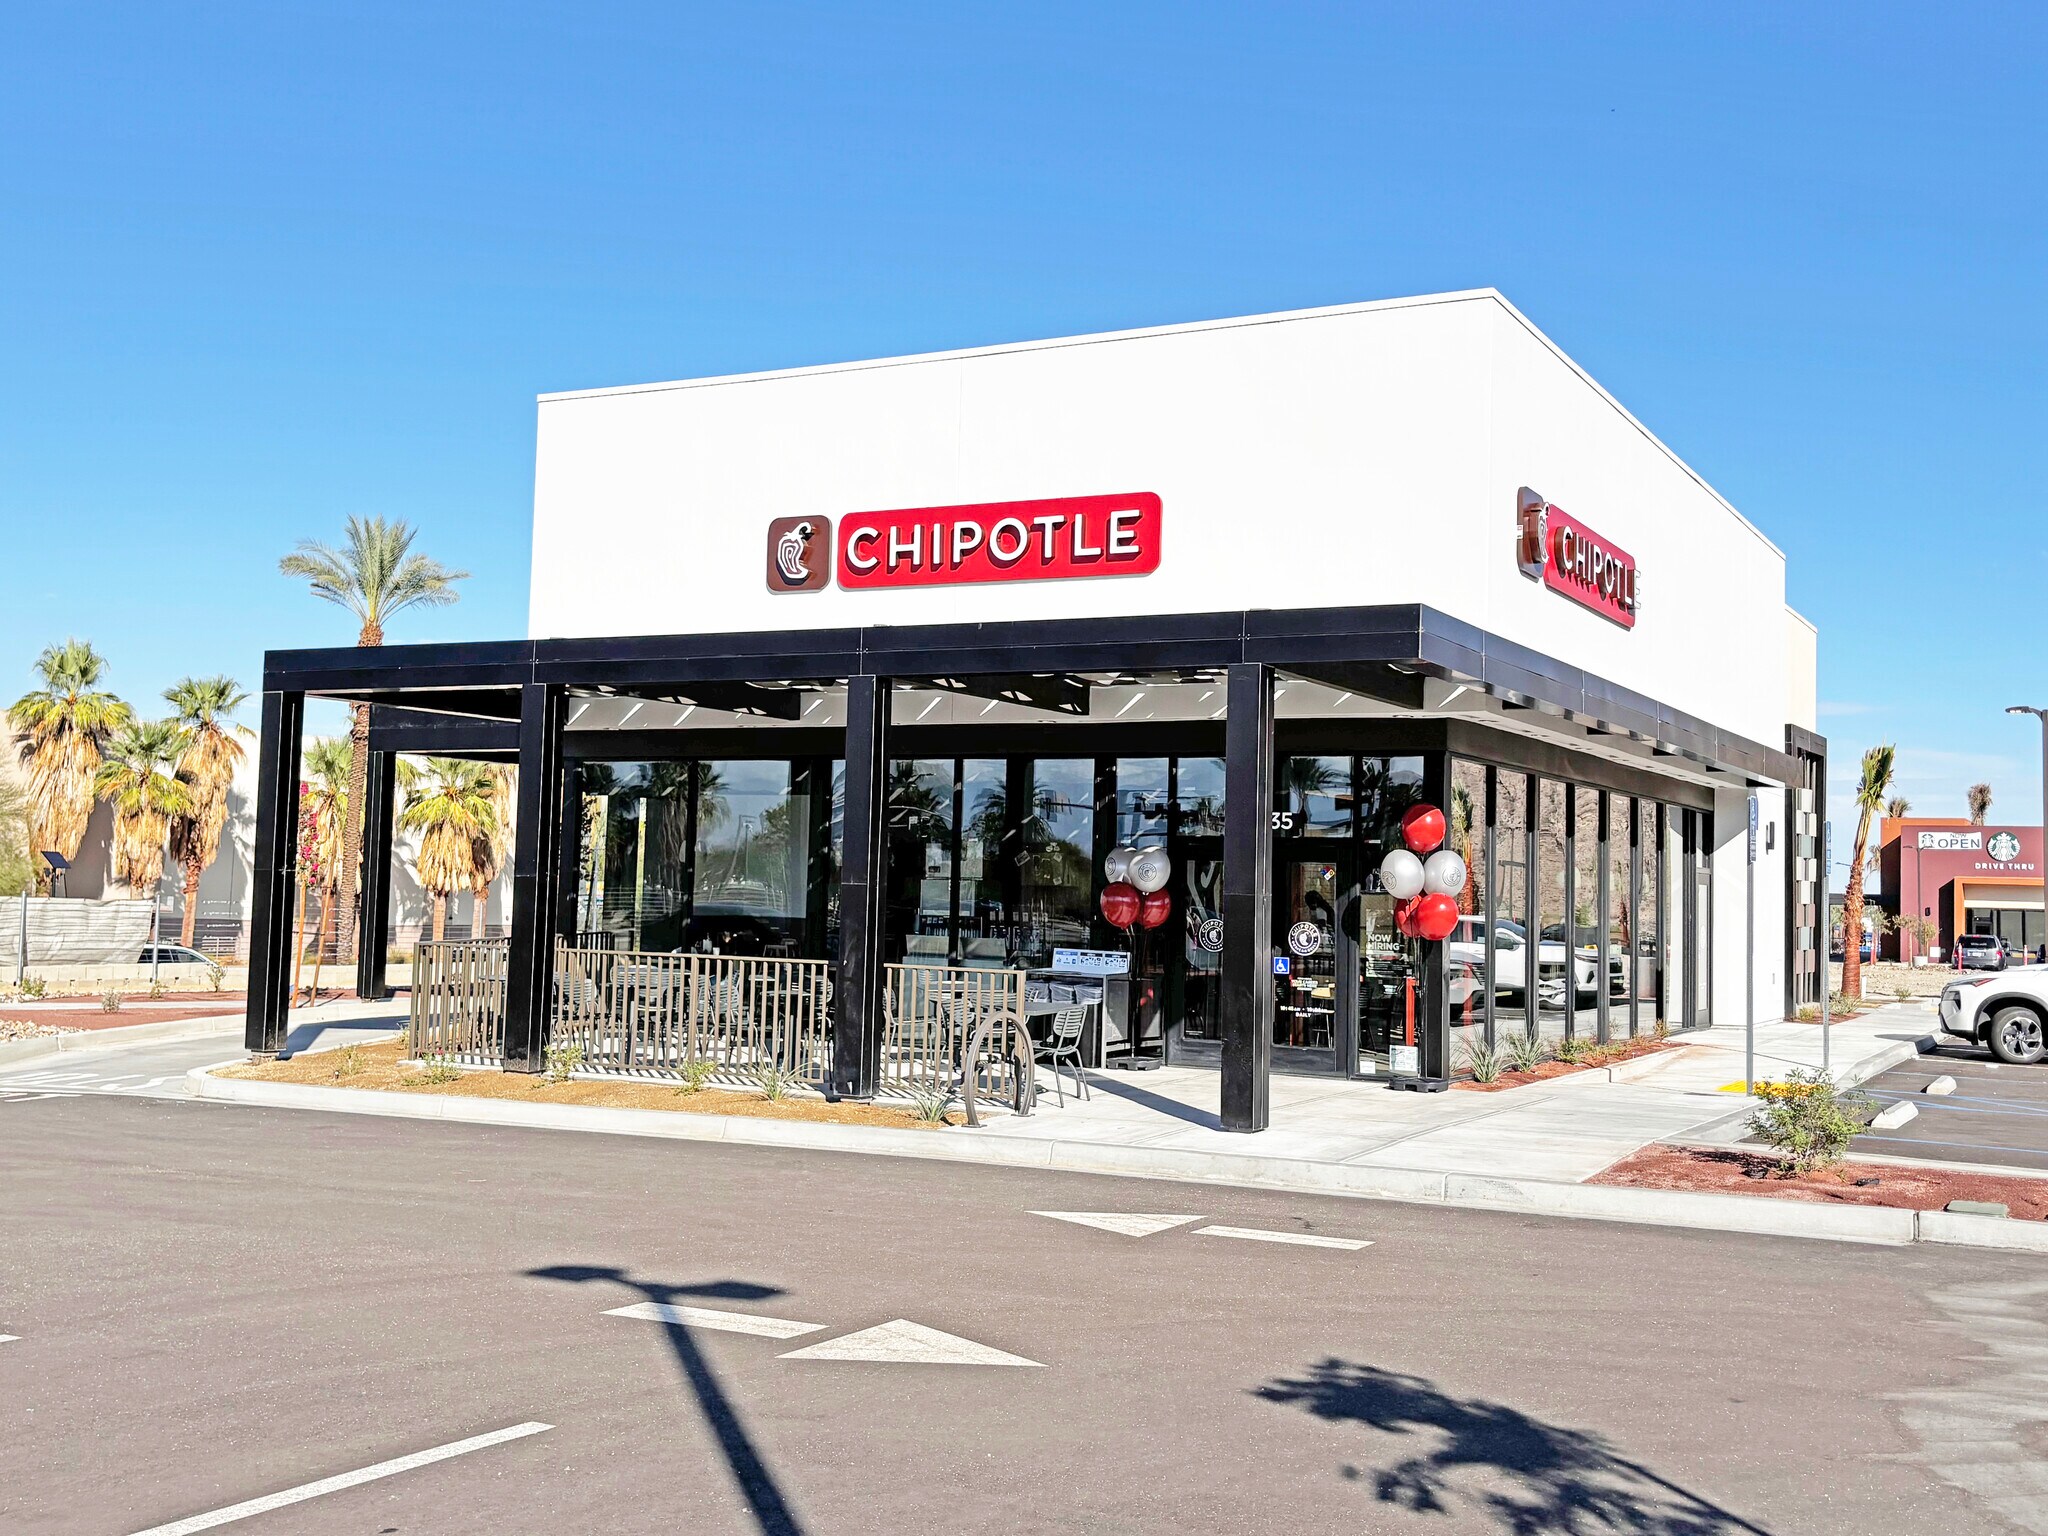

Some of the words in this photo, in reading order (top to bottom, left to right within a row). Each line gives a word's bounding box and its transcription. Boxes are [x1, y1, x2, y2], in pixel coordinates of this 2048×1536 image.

[846, 509, 1141, 575] CHIPOTLE
[1271, 811, 1293, 830] 35
[1937, 838, 1980, 849] OPEN
[1974, 862, 2004, 870] DRIVE
[2007, 862, 2035, 870] THRU
[1368, 934, 1391, 942] NOW
[1366, 942, 1400, 951] HIRING
